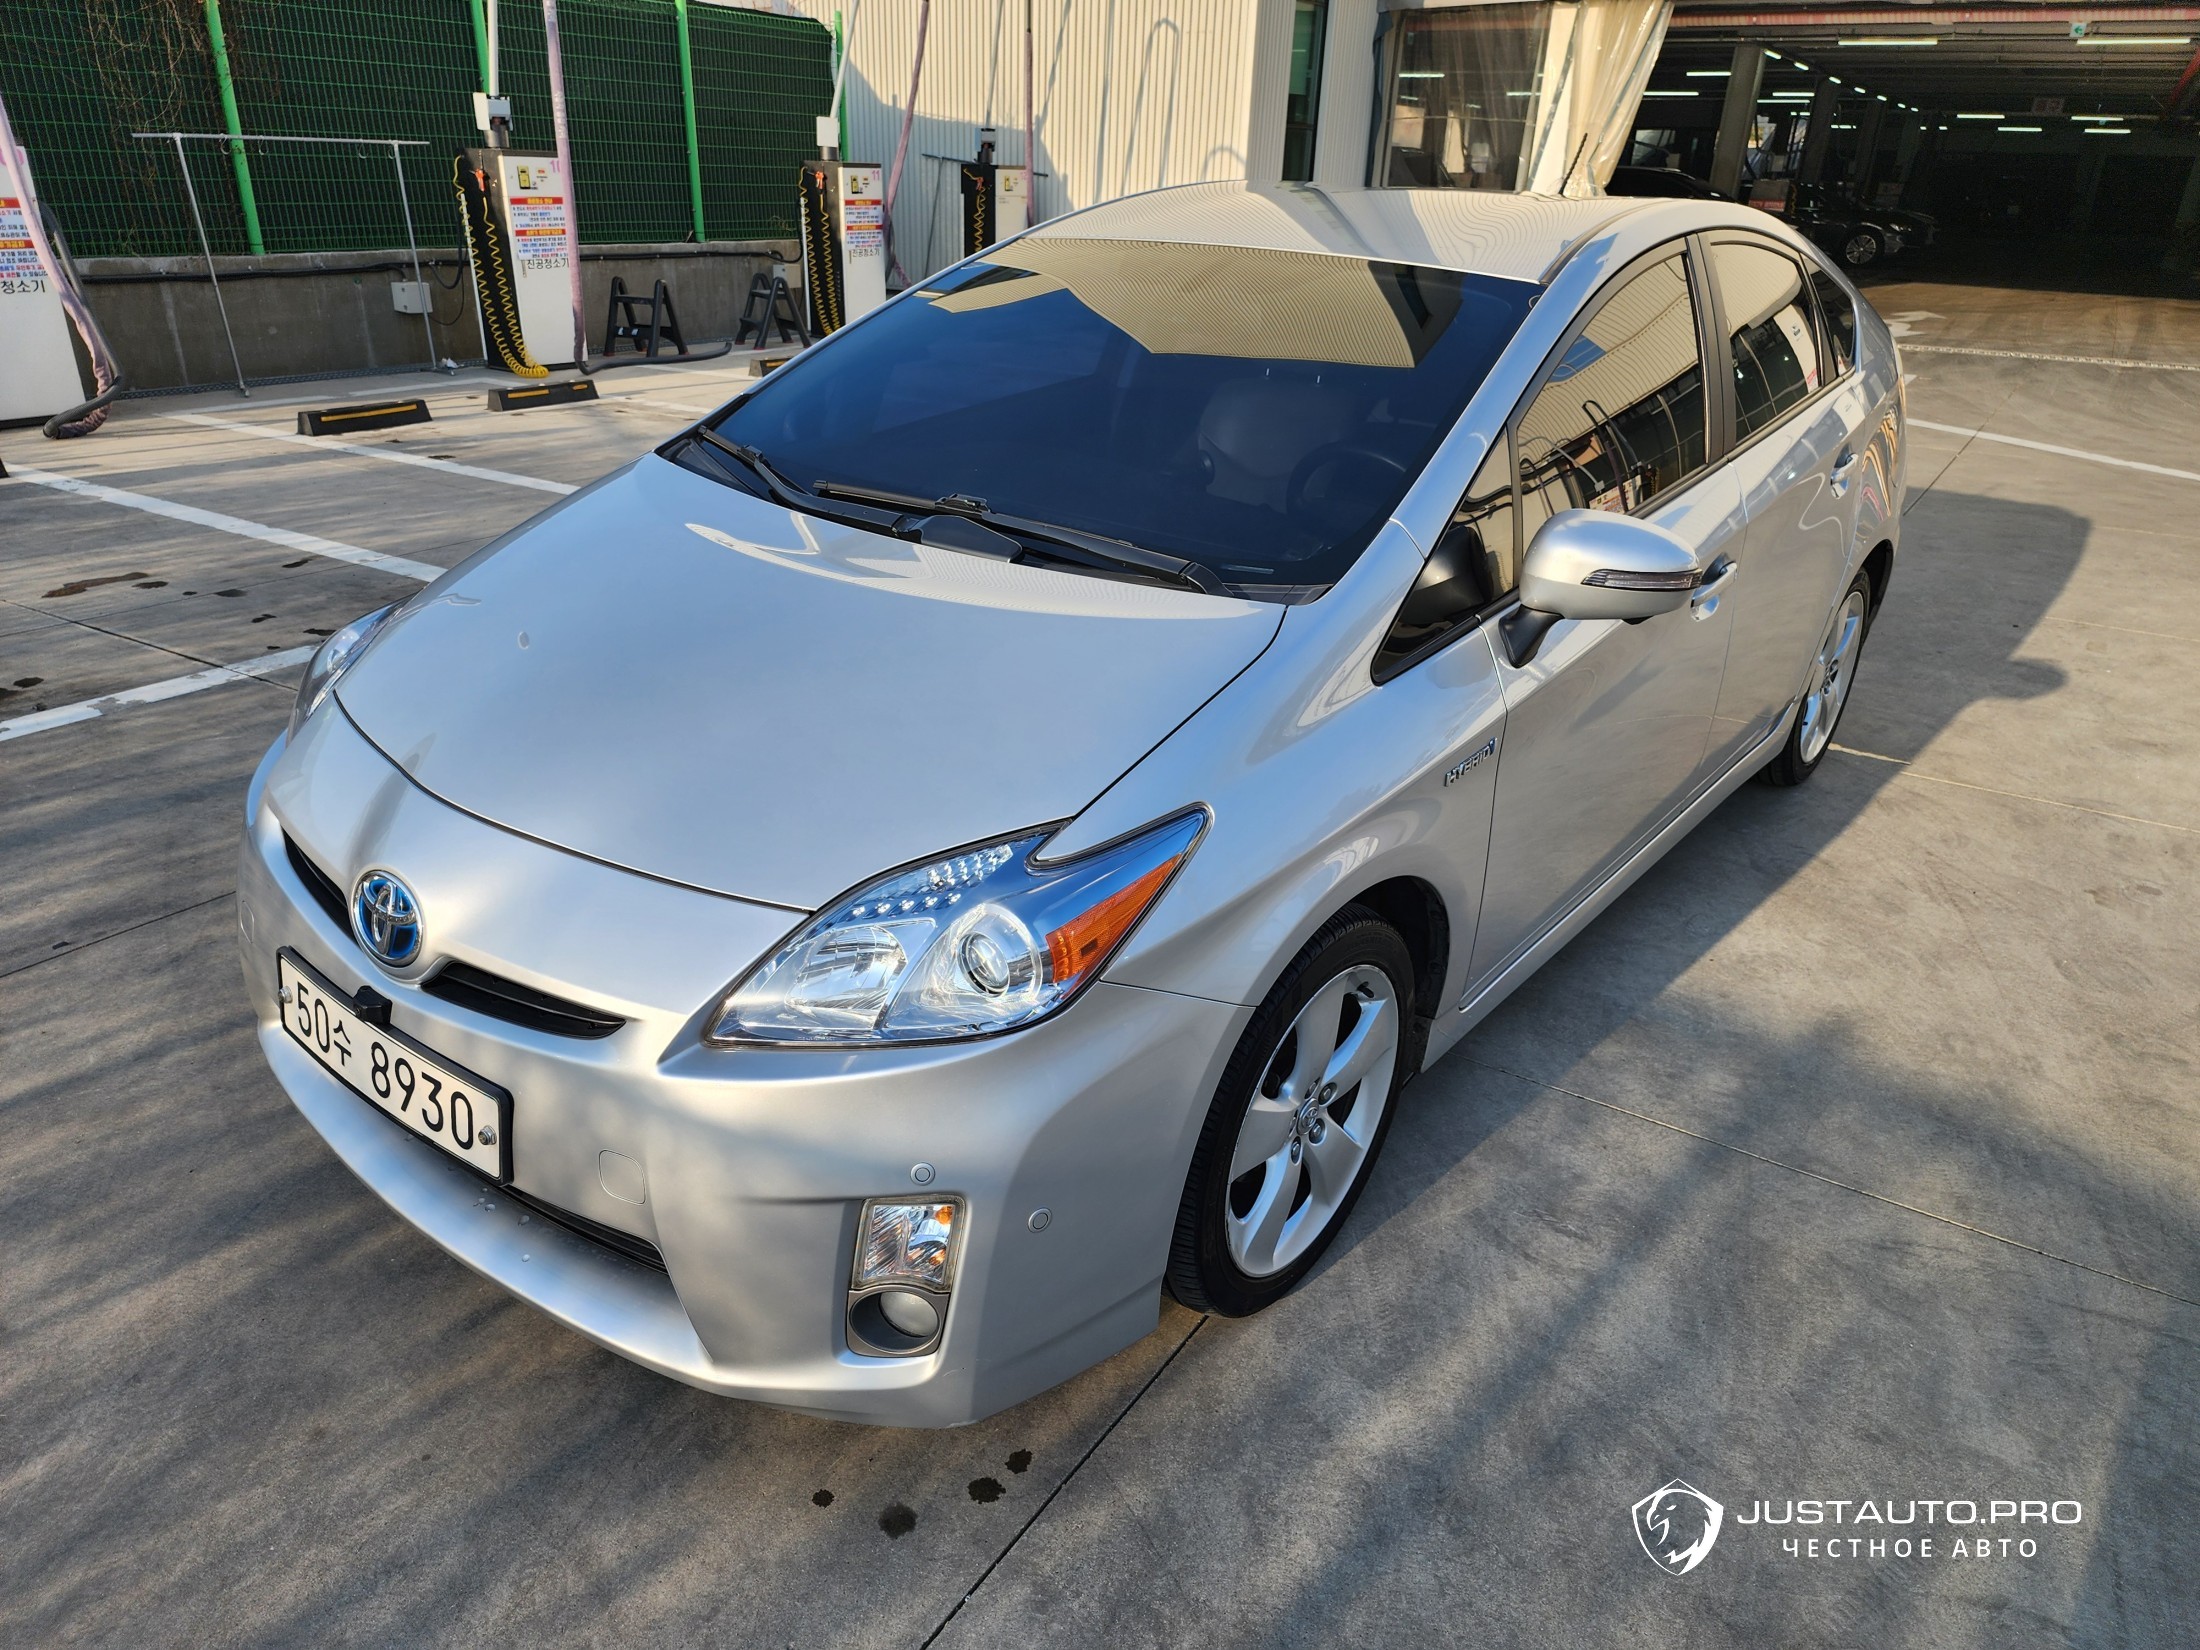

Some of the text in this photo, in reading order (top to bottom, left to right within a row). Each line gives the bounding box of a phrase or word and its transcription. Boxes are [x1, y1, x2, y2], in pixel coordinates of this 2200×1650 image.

[872, 170, 880, 181] 11
[852, 249, 880, 257] 진공청소기
[527, 258, 569, 269] 진공청소기
[0, 280, 45, 294] 청소기
[297, 981, 474, 1150] 50수 8930
